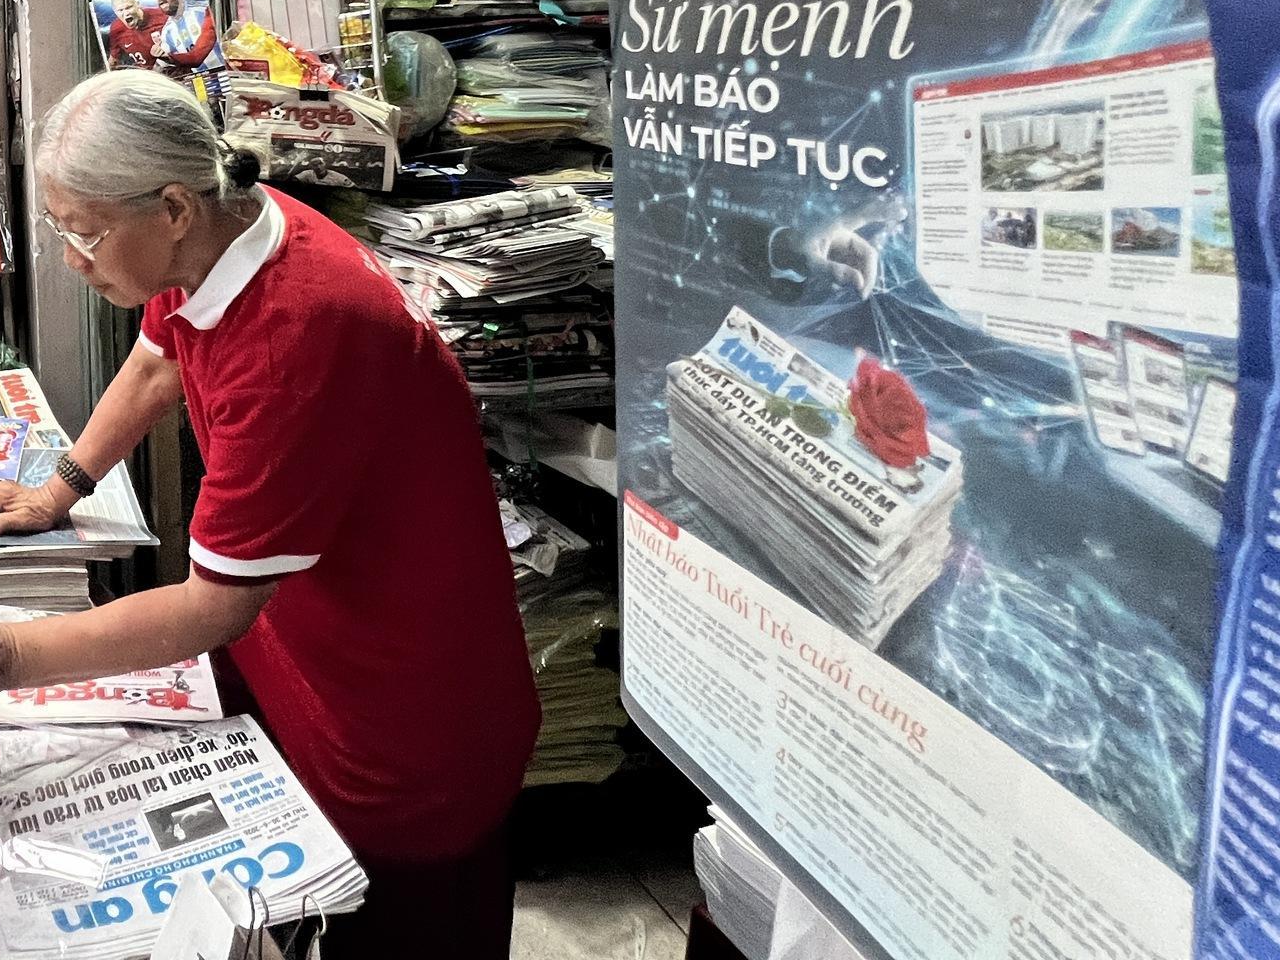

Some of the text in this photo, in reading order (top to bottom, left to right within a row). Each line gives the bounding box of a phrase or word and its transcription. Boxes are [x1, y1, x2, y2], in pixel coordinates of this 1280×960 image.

[624, 65, 781, 115] LÀM BÁO
[622, 108, 889, 192] VẪN TIẾP TỤC
[626, 513, 664, 556] Nhật
[665, 541, 698, 581] báo
[703, 567, 749, 621] Tuổi
[754, 600, 794, 648] Trẻ
[799, 642, 852, 690] cuối
[857, 682, 928, 754] cùng
[157, 746, 194, 769] điện
[196, 739, 215, 757] xe
[214, 748, 259, 772] Ngăn
[70, 767, 105, 795] giới
[107, 756, 153, 781] trong
[168, 761, 212, 786] chặn
[106, 783, 138, 808] họa
[142, 774, 168, 797] tai
[198, 841, 241, 862] THÀNH
[130, 866, 152, 883] CHÍ
[151, 860, 172, 876] HỒ
[51, 896, 134, 935] an
